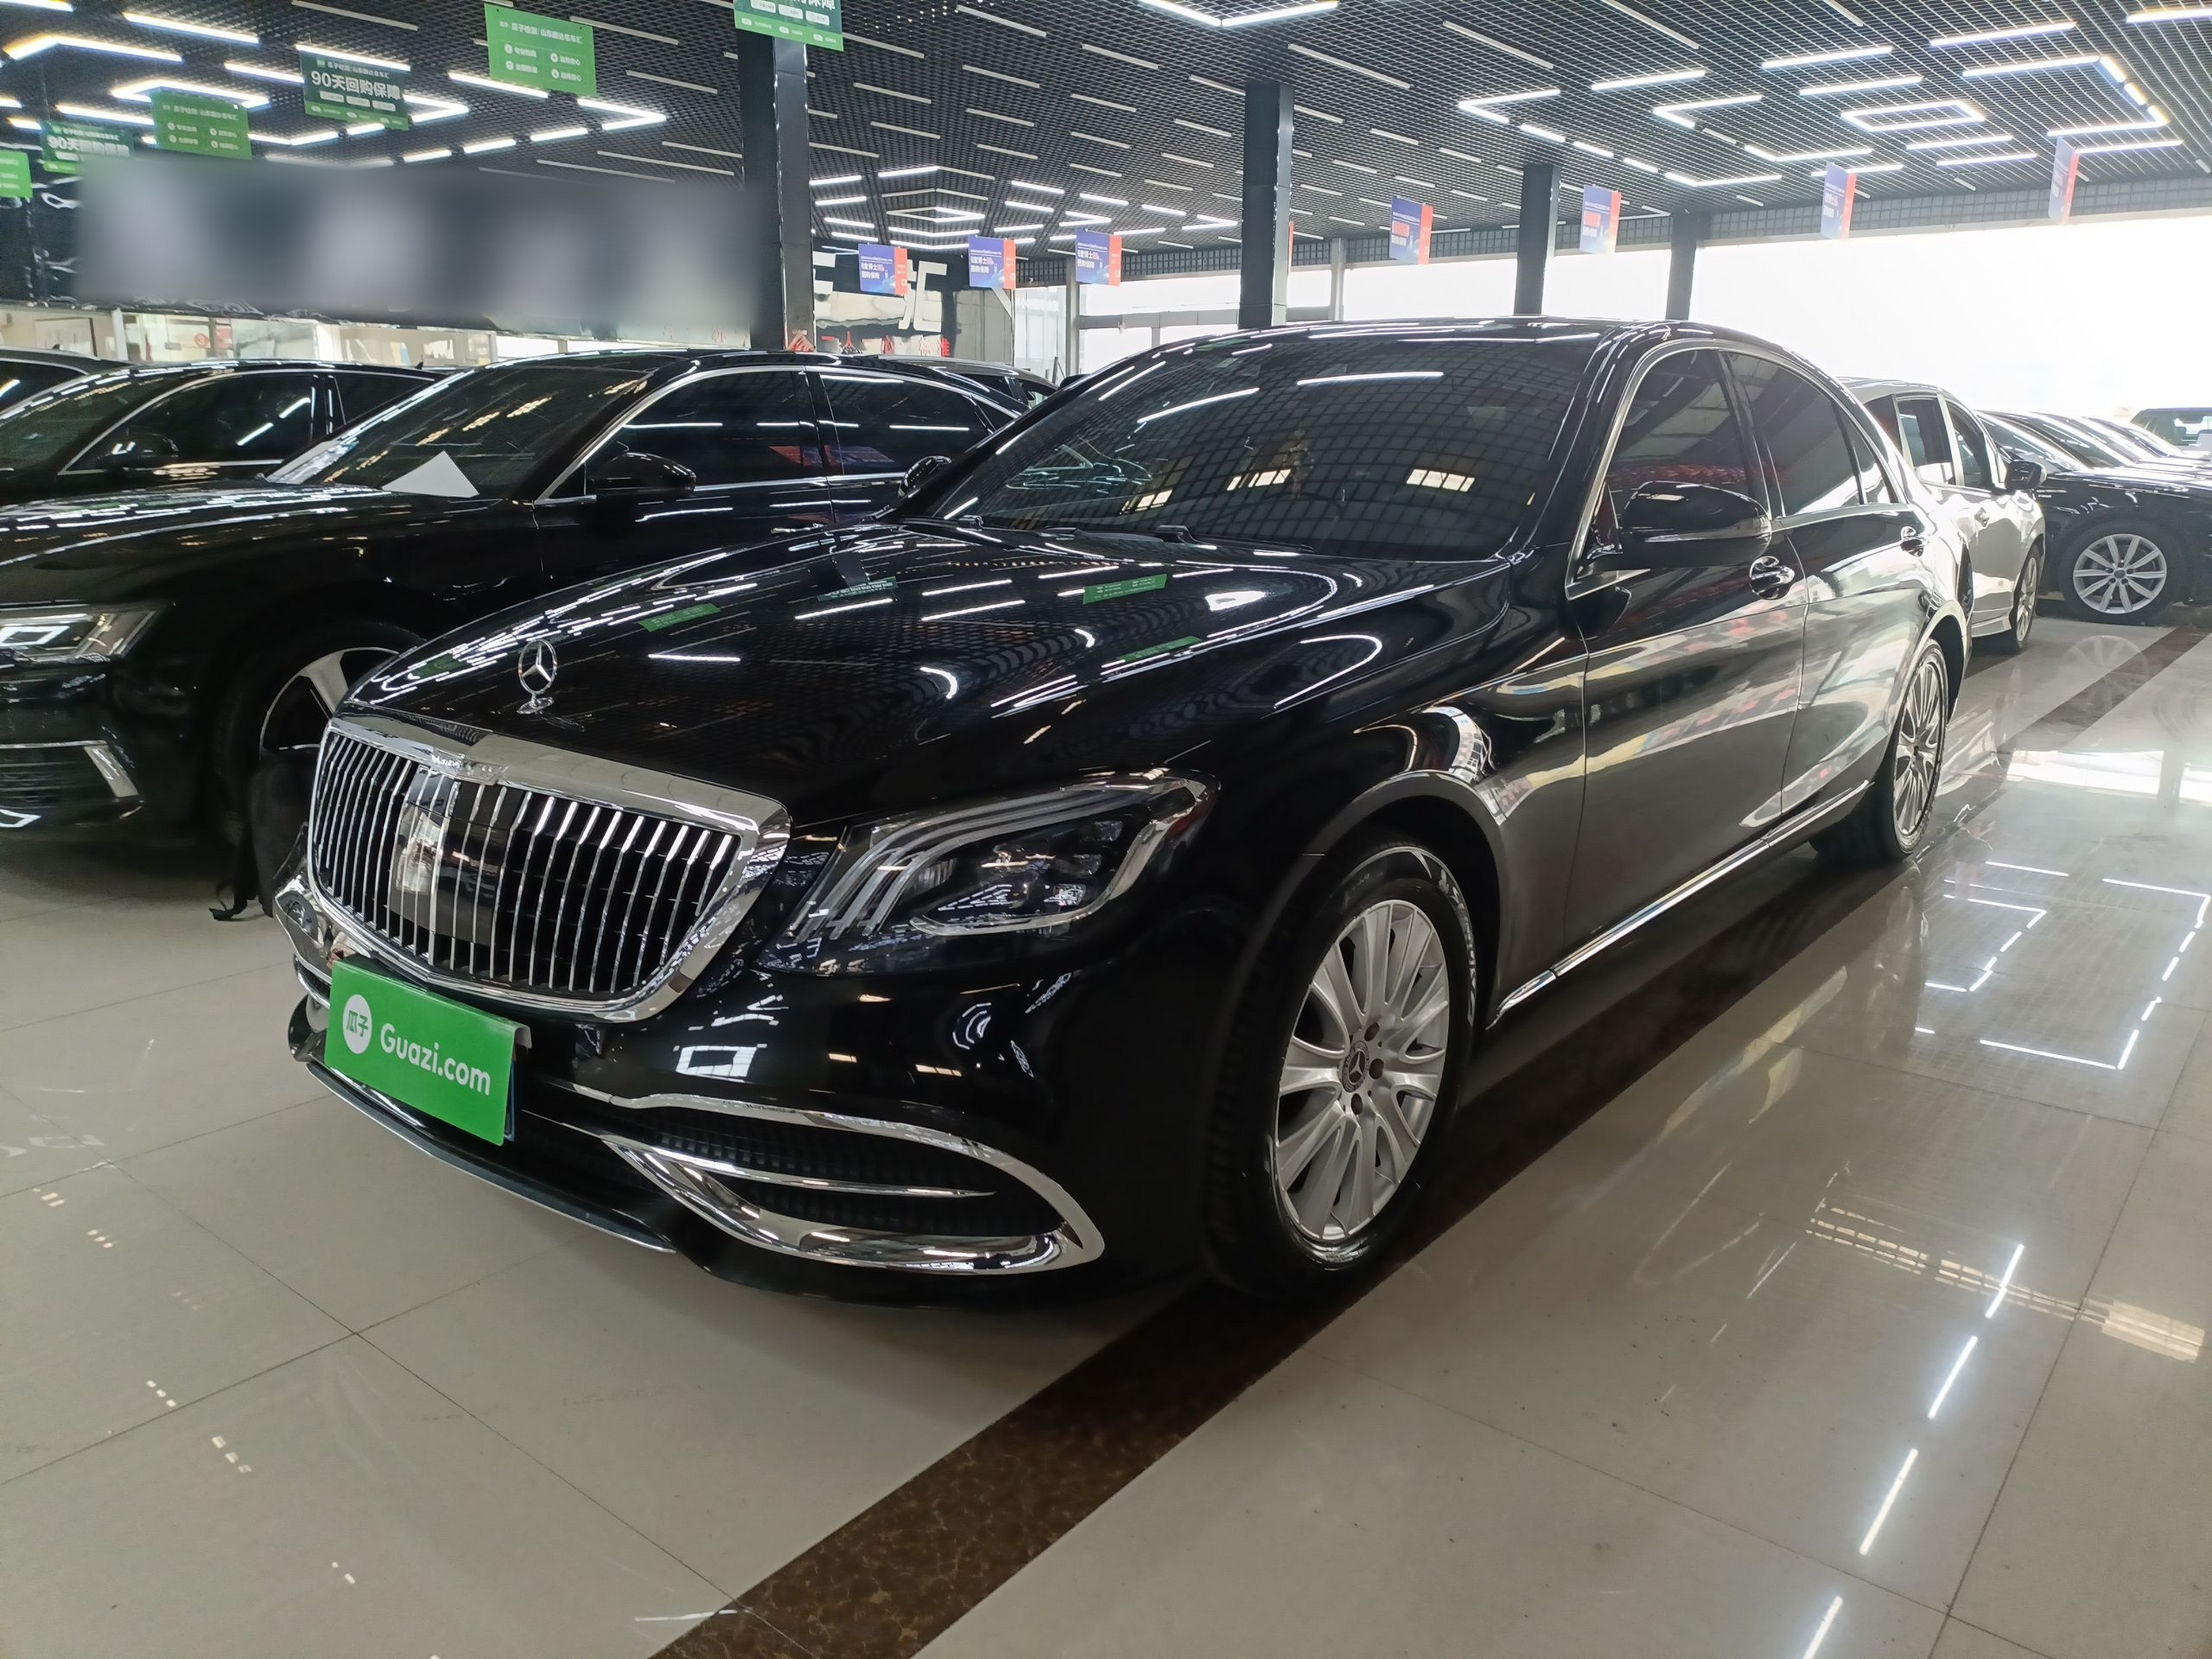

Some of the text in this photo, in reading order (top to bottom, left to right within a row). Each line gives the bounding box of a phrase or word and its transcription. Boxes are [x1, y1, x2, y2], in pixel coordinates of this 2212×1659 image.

[310, 70, 402, 100] 90天回购保障
[346, 1010, 369, 1037] 瓜子
[380, 1022, 491, 1096] Guazi.com
